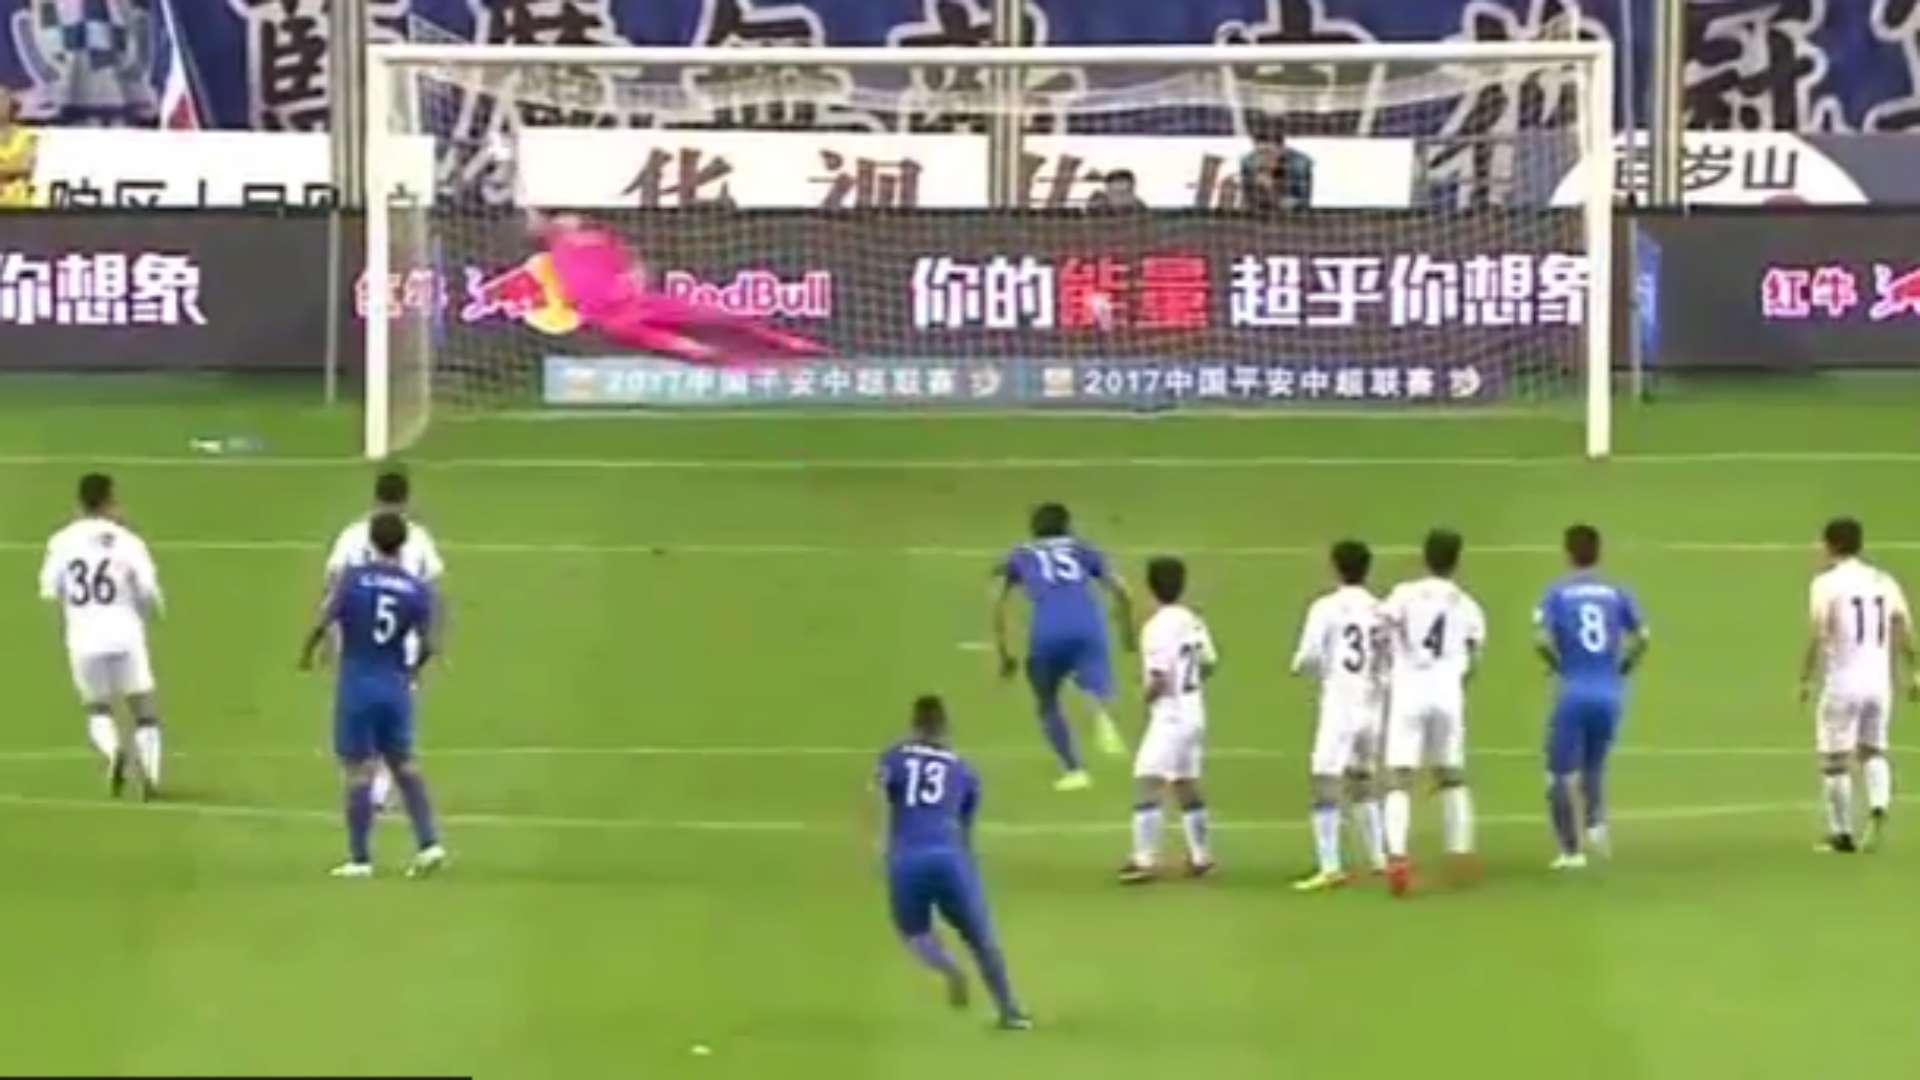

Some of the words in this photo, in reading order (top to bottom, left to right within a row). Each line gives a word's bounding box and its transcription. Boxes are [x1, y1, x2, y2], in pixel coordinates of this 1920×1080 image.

[1614, 145, 1798, 191] 百岁山
[0, 253, 206, 326] 你想象
[911, 256, 1210, 330] 你的能量
[1231, 254, 1590, 327] 超乎你想象
[1762, 267, 1857, 317] 红牛
[67, 558, 116, 606] 36
[1035, 548, 1081, 583] 15
[372, 594, 398, 644] 5
[1422, 610, 1447, 660] 4
[1579, 602, 1607, 652] 8
[1851, 595, 1887, 646] 11
[904, 757, 949, 807] 13
